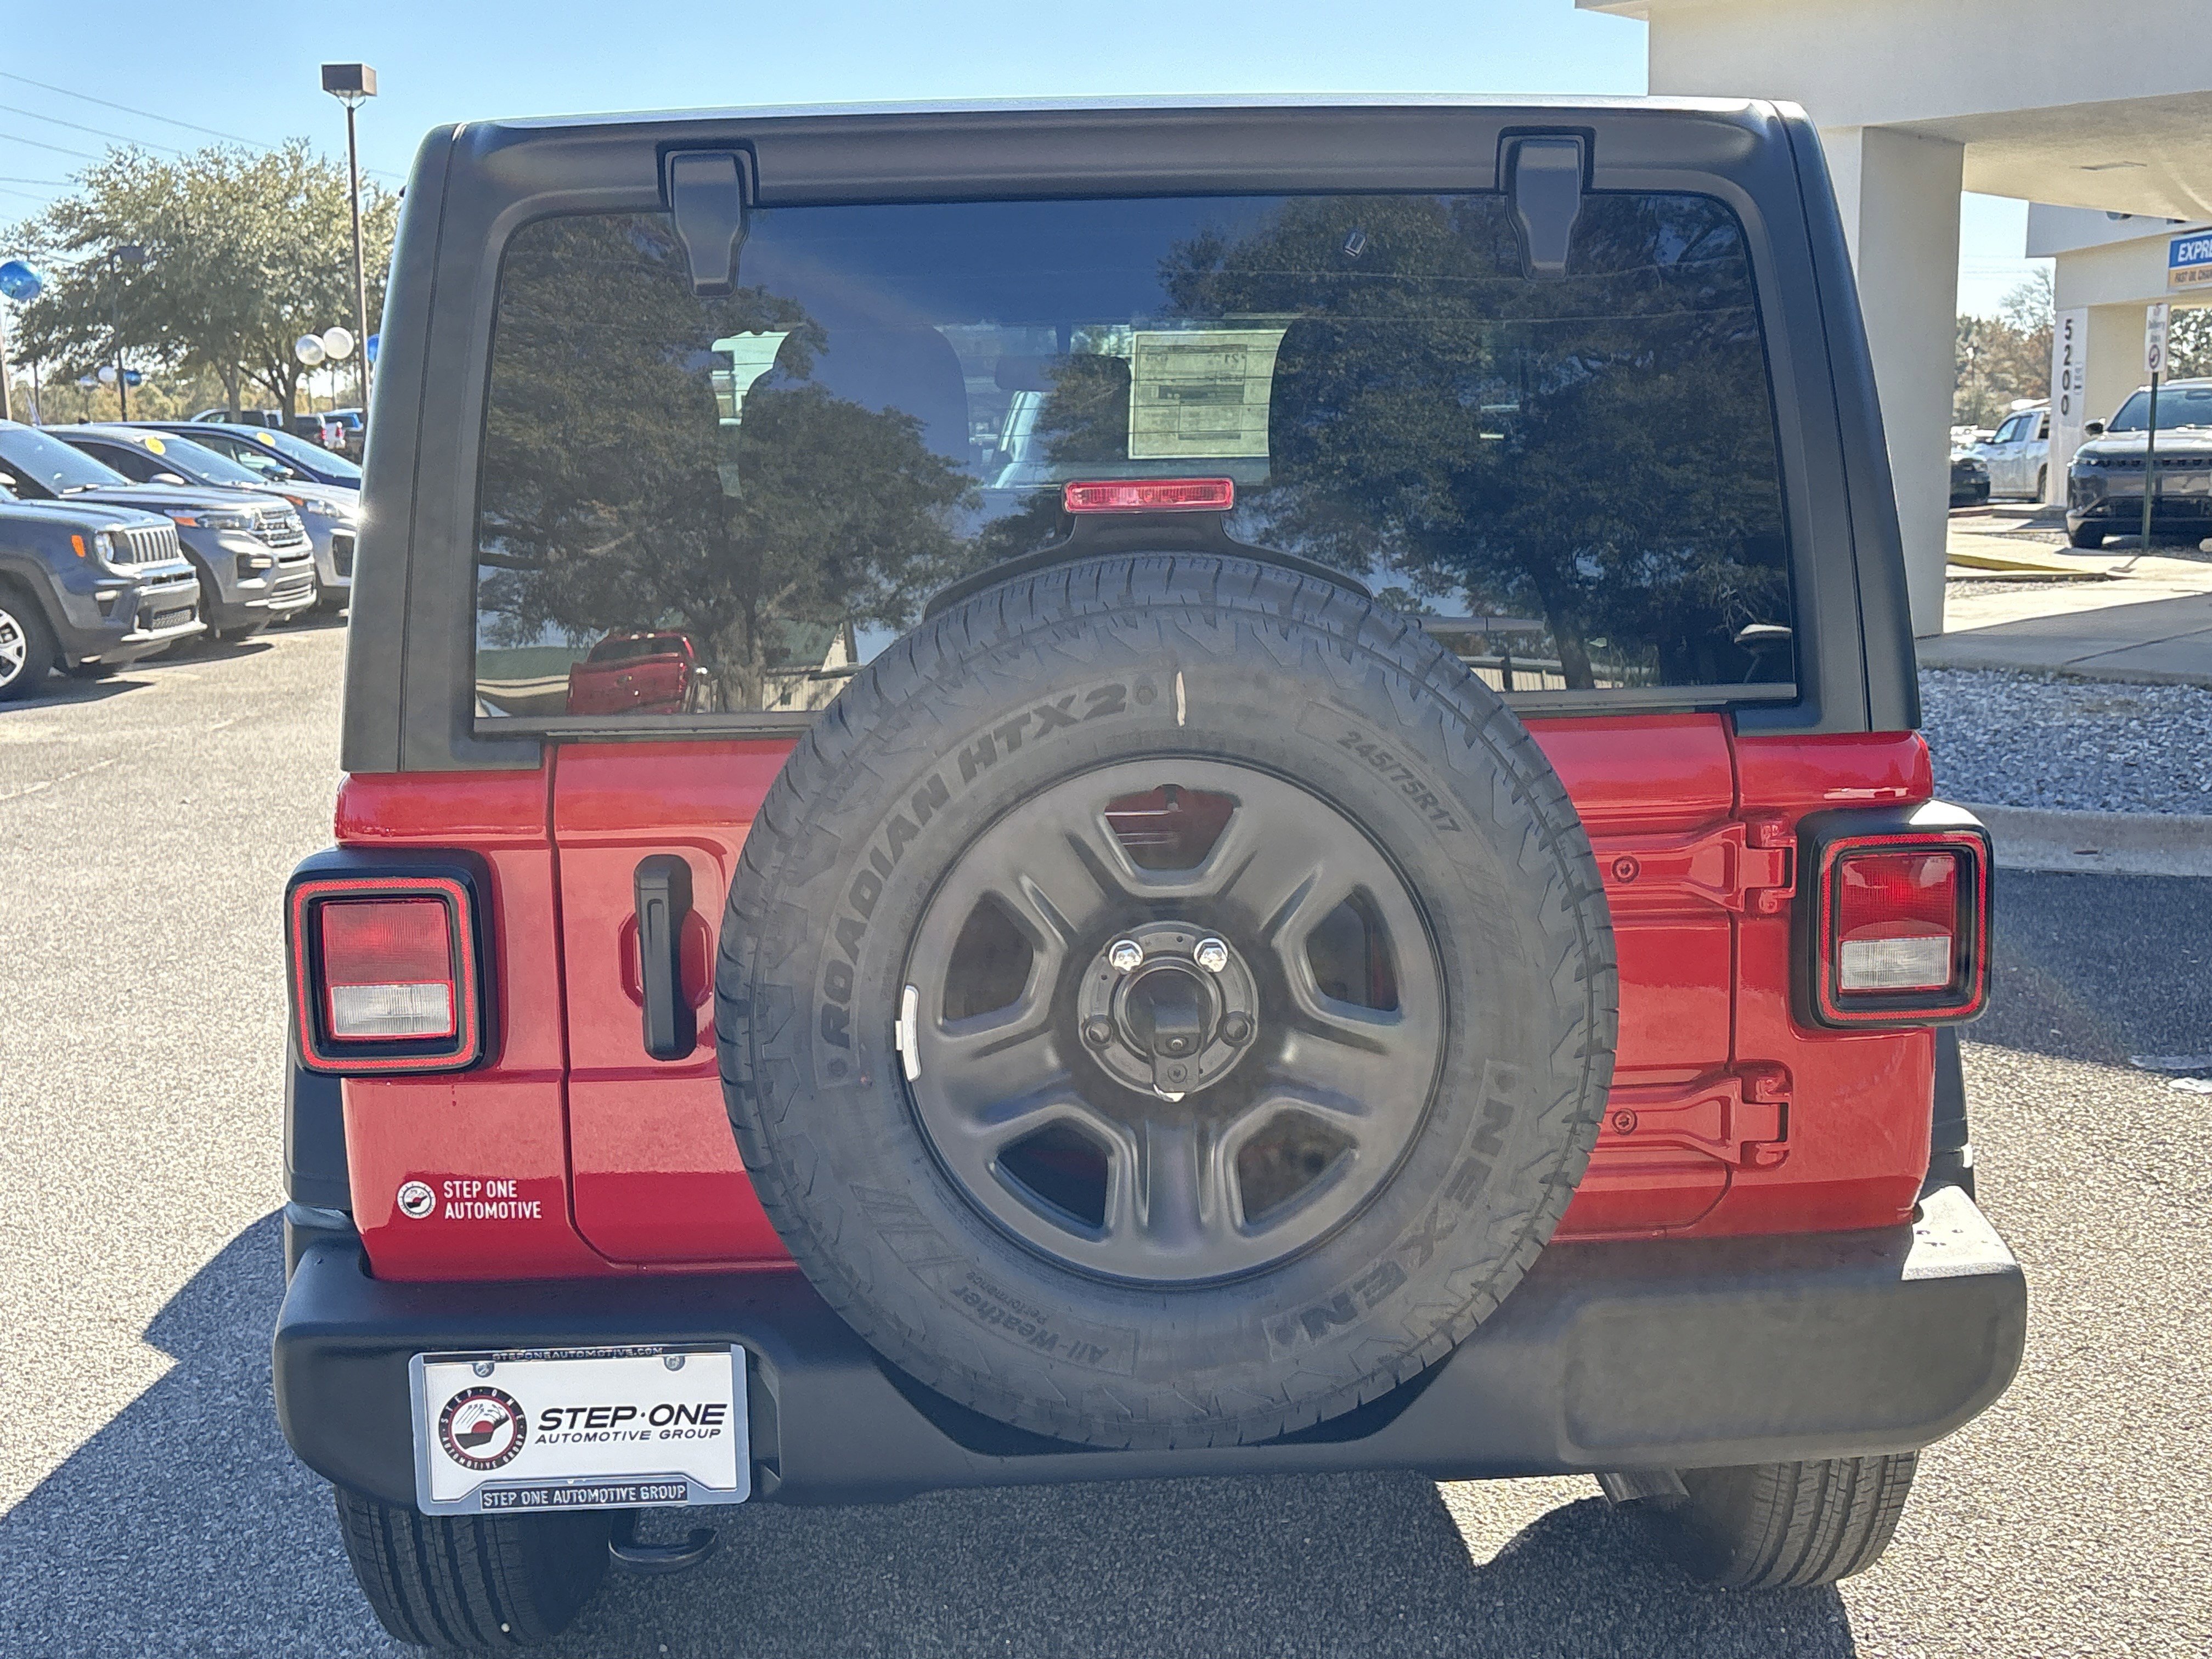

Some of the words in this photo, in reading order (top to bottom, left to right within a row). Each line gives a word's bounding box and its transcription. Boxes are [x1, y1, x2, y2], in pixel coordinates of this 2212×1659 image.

[2061, 318, 2073, 416] 5200
[1337, 731, 1462, 832] 245/75R17
[821, 776, 950, 1050] ROADIAN
[958, 683, 1127, 789] HTX2
[443, 1180, 482, 1198] STEP
[486, 1180, 517, 1198] ONE
[445, 1201, 542, 1219] AUTOMOTIVE
[1300, 1098, 1514, 1342] NEXEN
[492, 1347, 663, 1361] STEPONEAUTOMOTIVE.COM
[535, 1430, 652, 1444] AUTOMOTIVE
[658, 1428, 721, 1440] GROUP
[442, 1437, 498, 1470] AUTOMOTIVE
[503, 1434, 524, 1463] GROUP
[483, 1492, 517, 1507] STEP
[521, 1490, 549, 1505] ONE
[553, 1487, 636, 1504] AUTOMOTIVE
[640, 1485, 686, 1500] GROUP
